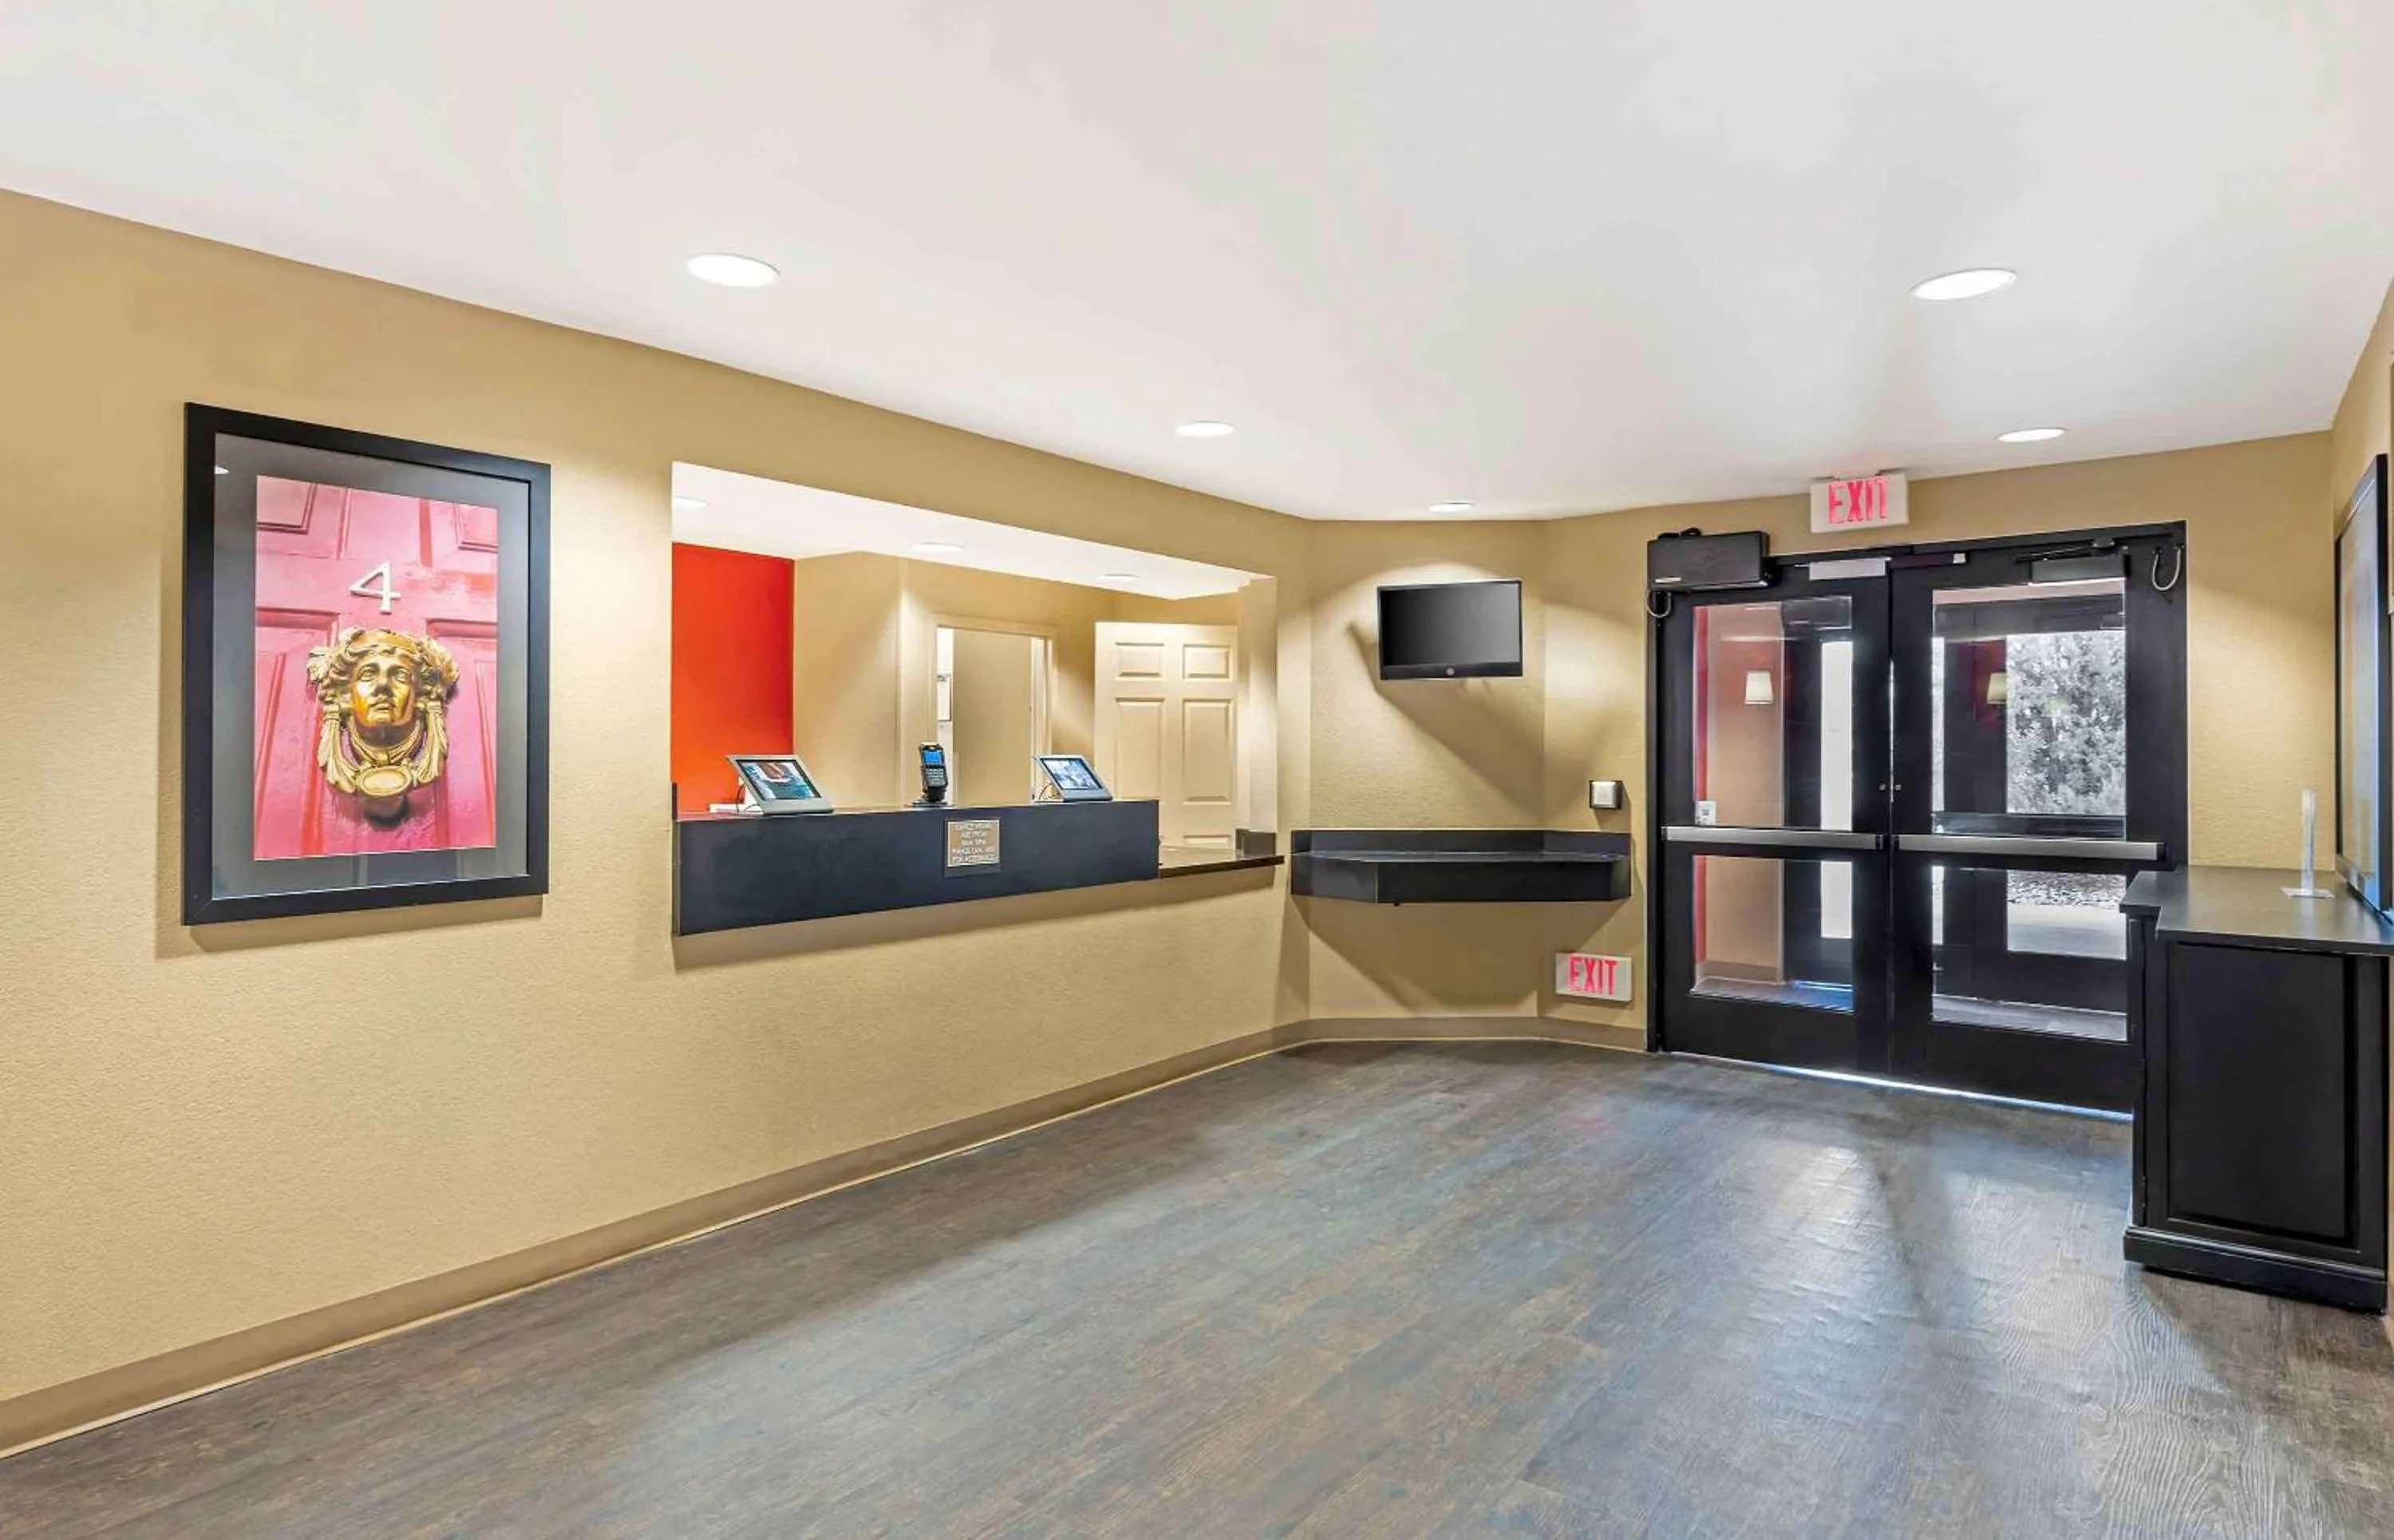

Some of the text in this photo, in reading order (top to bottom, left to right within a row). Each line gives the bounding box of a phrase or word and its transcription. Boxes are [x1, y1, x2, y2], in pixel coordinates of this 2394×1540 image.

[1827, 478, 1890, 524] EXIT
[349, 561, 401, 614] 4
[1569, 955, 1619, 996] EXIT
